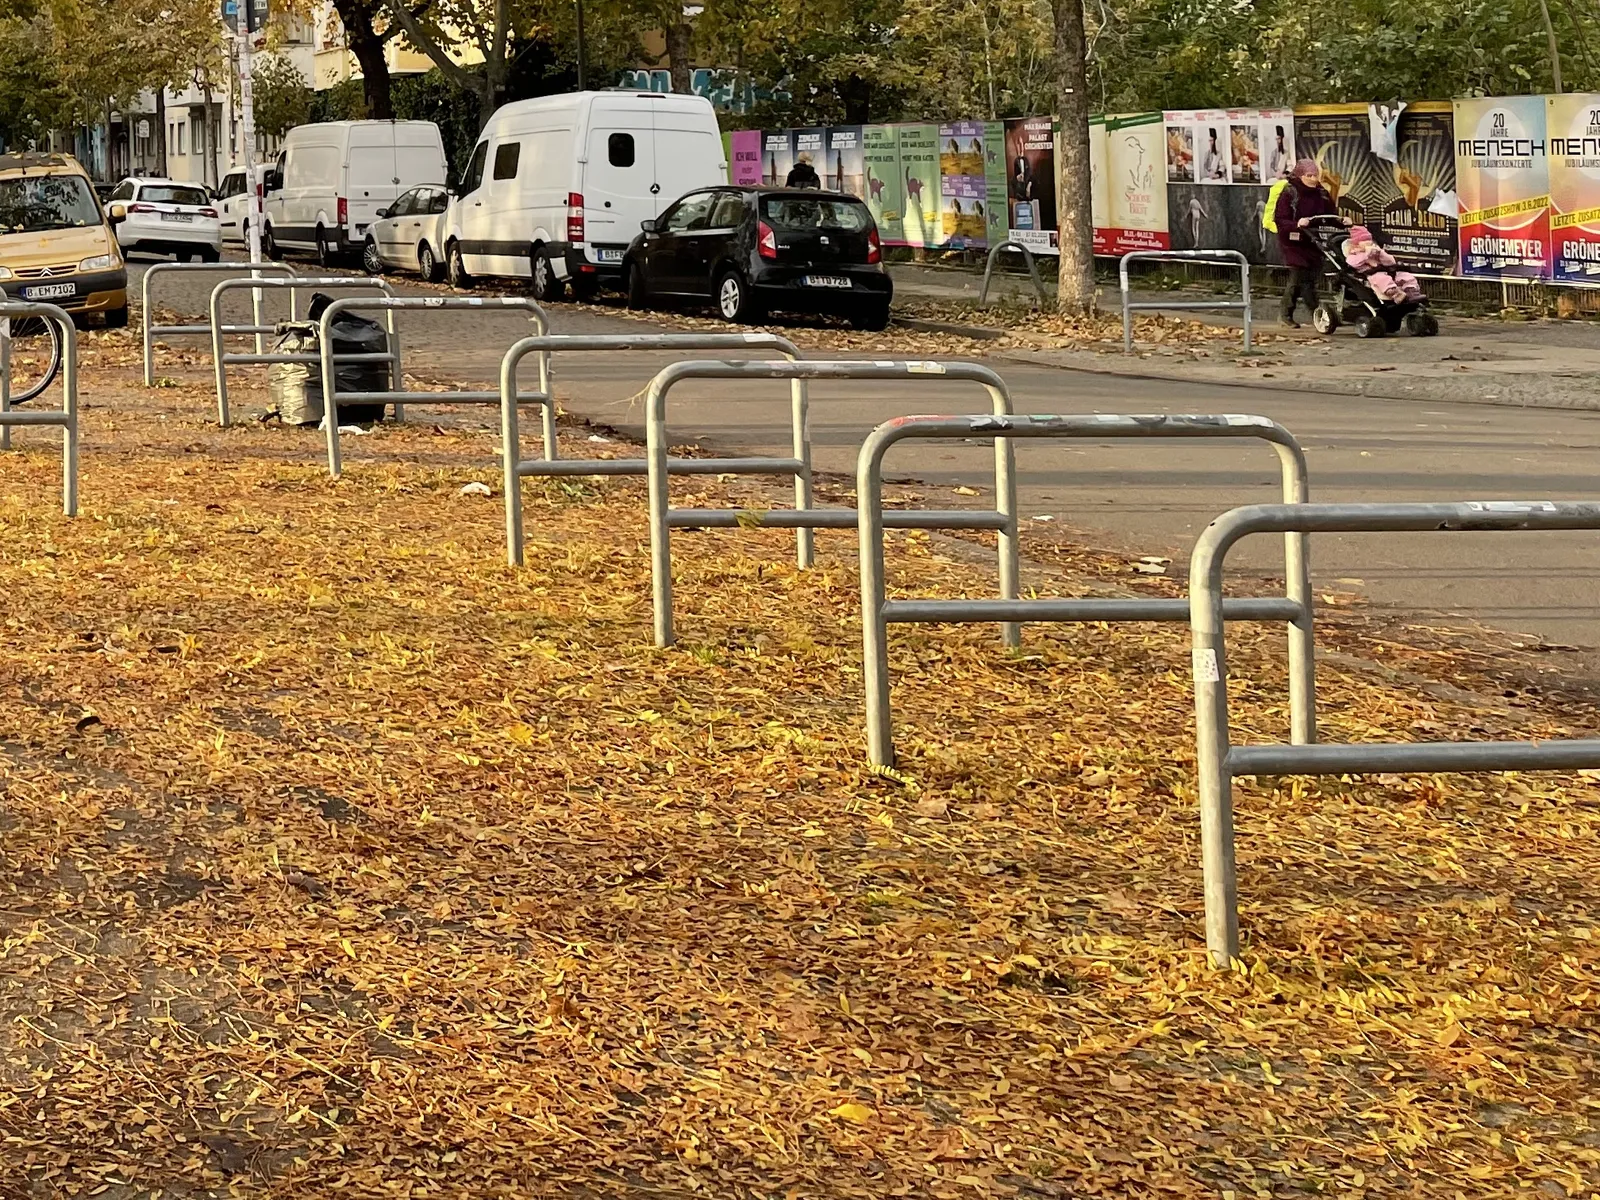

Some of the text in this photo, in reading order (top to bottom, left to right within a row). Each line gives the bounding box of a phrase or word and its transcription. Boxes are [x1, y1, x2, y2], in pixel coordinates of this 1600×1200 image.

[1493, 113, 1505, 128] 20
[1490, 128, 1509, 138] JAHRE
[1458, 139, 1545, 156] MENSCH
[1551, 138, 1600, 155] MEN
[735, 151, 758, 162] ICH WILL
[1471, 158, 1533, 169] JUBILÄUMSKONZERTE
[1461, 196, 1549, 225] LETZTE ZUSATZSHOW 3.6.2022
[1385, 209, 1445, 229] BERLIN BERLIN
[1554, 213, 1576, 227] LETZTE
[1470, 235, 1543, 258] GRÖNEMEYER
[809, 276, 816, 284] B
[27, 286, 36, 297] B
